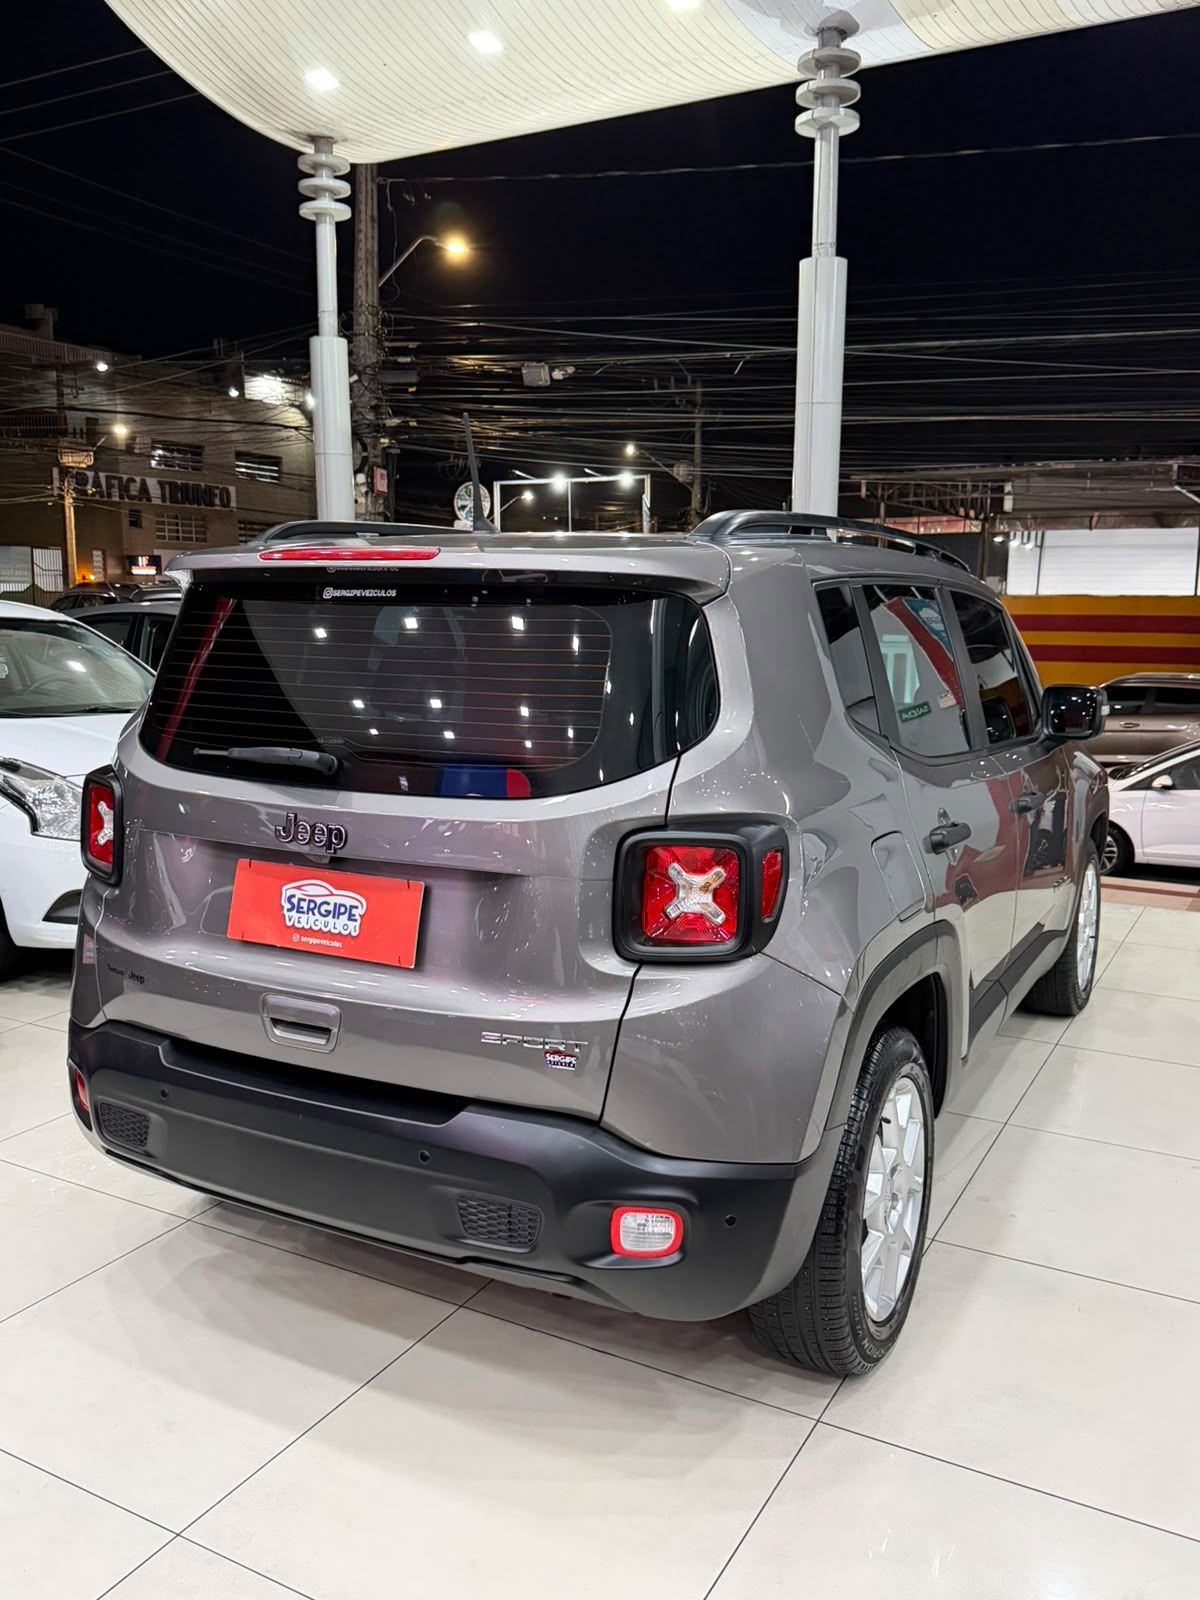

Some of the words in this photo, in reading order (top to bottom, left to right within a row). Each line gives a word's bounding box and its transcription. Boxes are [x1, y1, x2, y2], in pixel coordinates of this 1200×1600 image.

[158, 479, 232, 508] TRIUNFO
[275, 812, 347, 853] Jeep
[286, 894, 359, 922] SERGIPE
[288, 913, 358, 934] VEÍCULOS
[481, 1032, 588, 1052] SPORT
